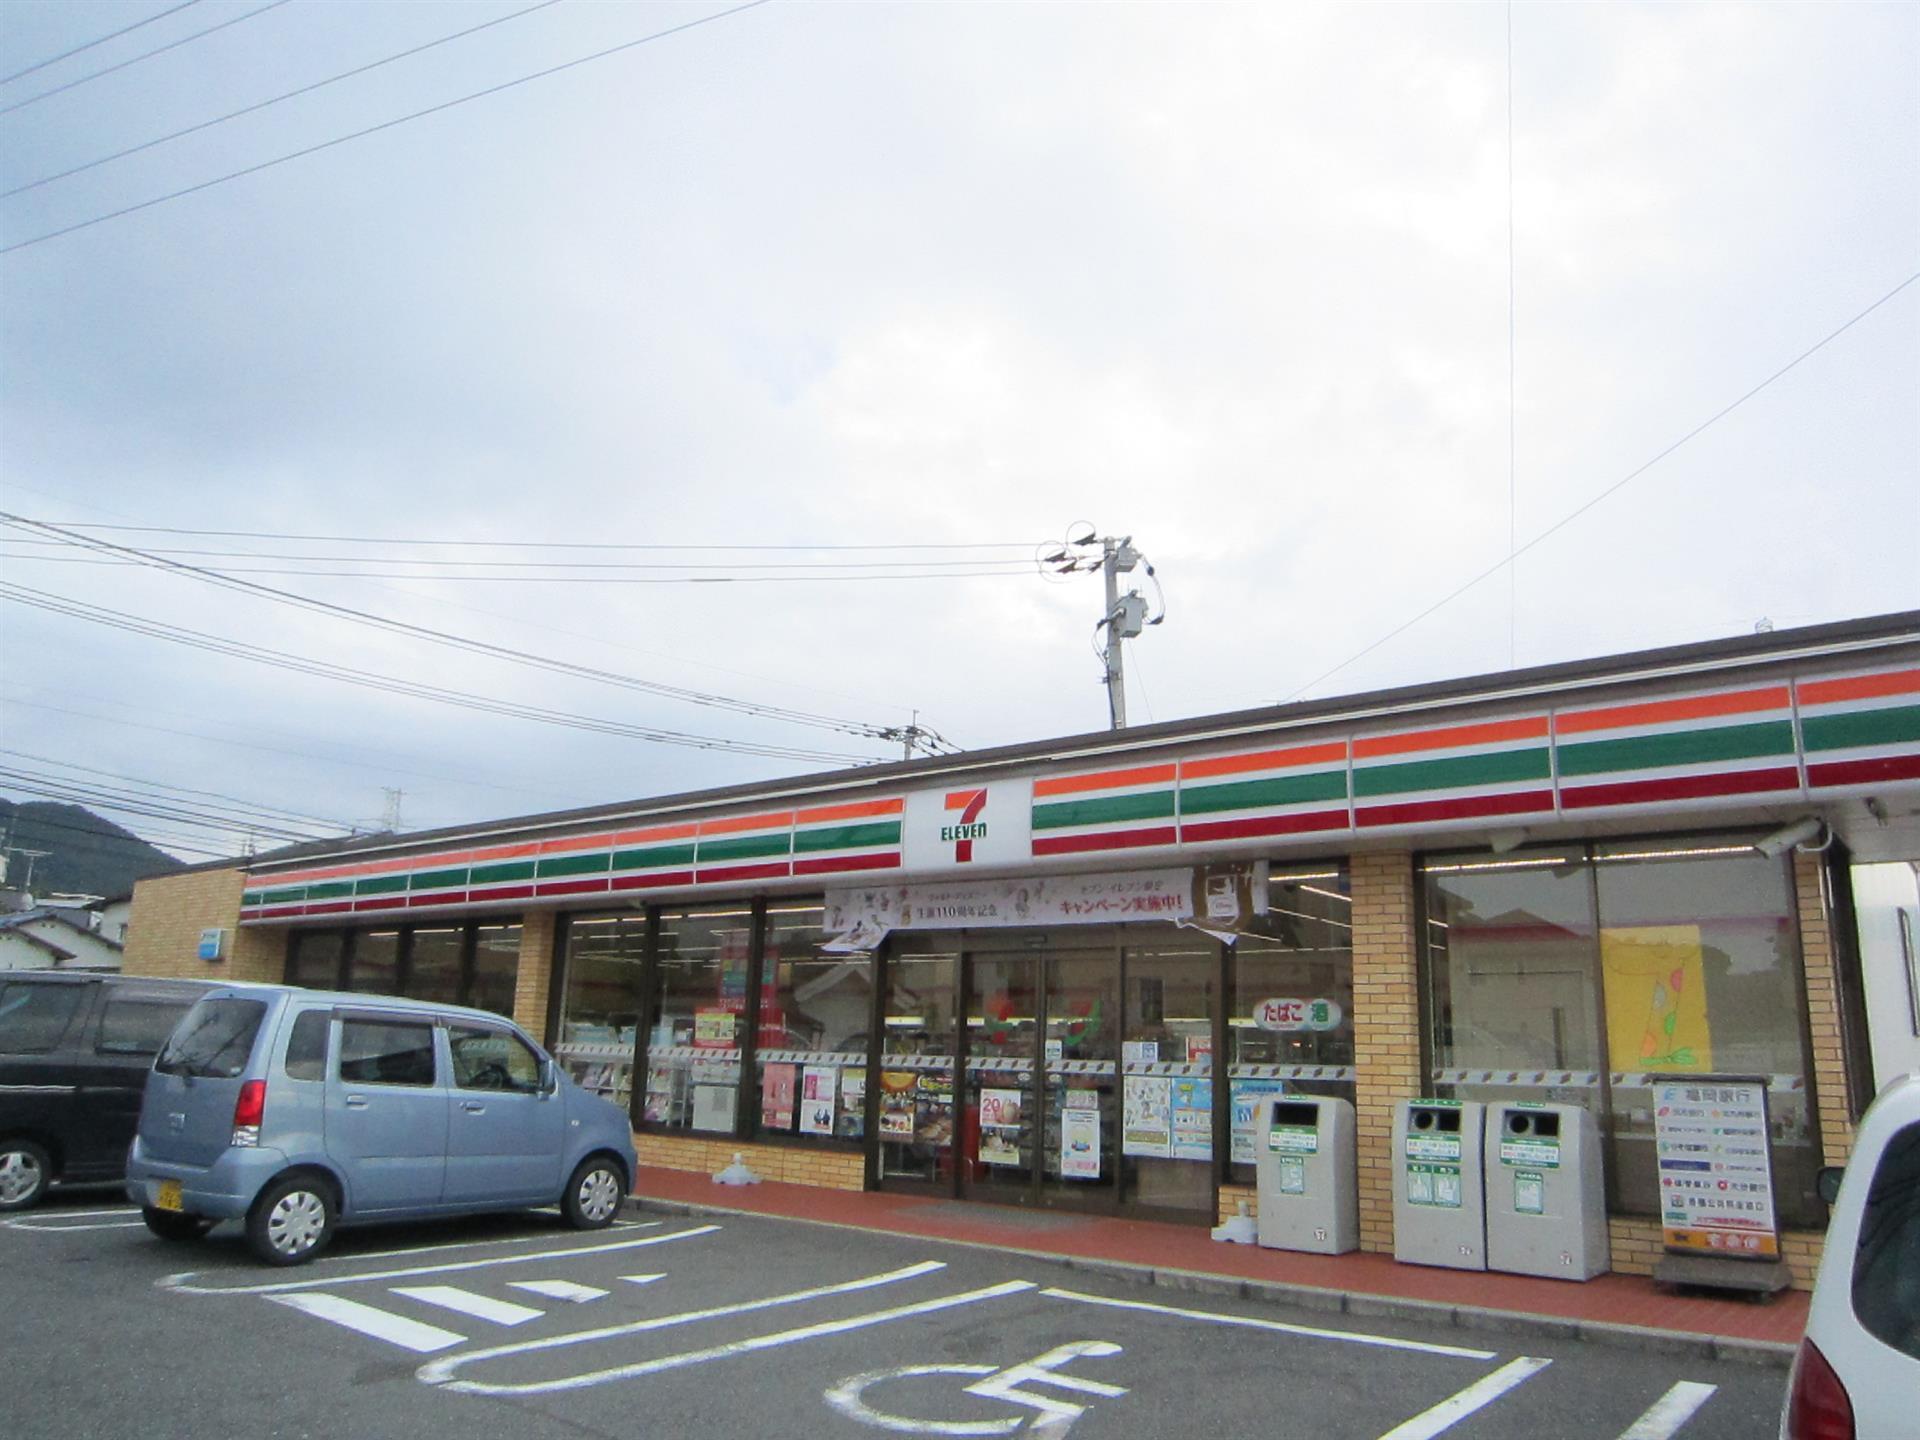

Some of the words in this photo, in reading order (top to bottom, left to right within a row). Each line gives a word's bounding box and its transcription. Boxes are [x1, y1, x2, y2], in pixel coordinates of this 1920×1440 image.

[944, 788, 987, 863] 7
[1263, 1003, 1303, 1022] たばこ
